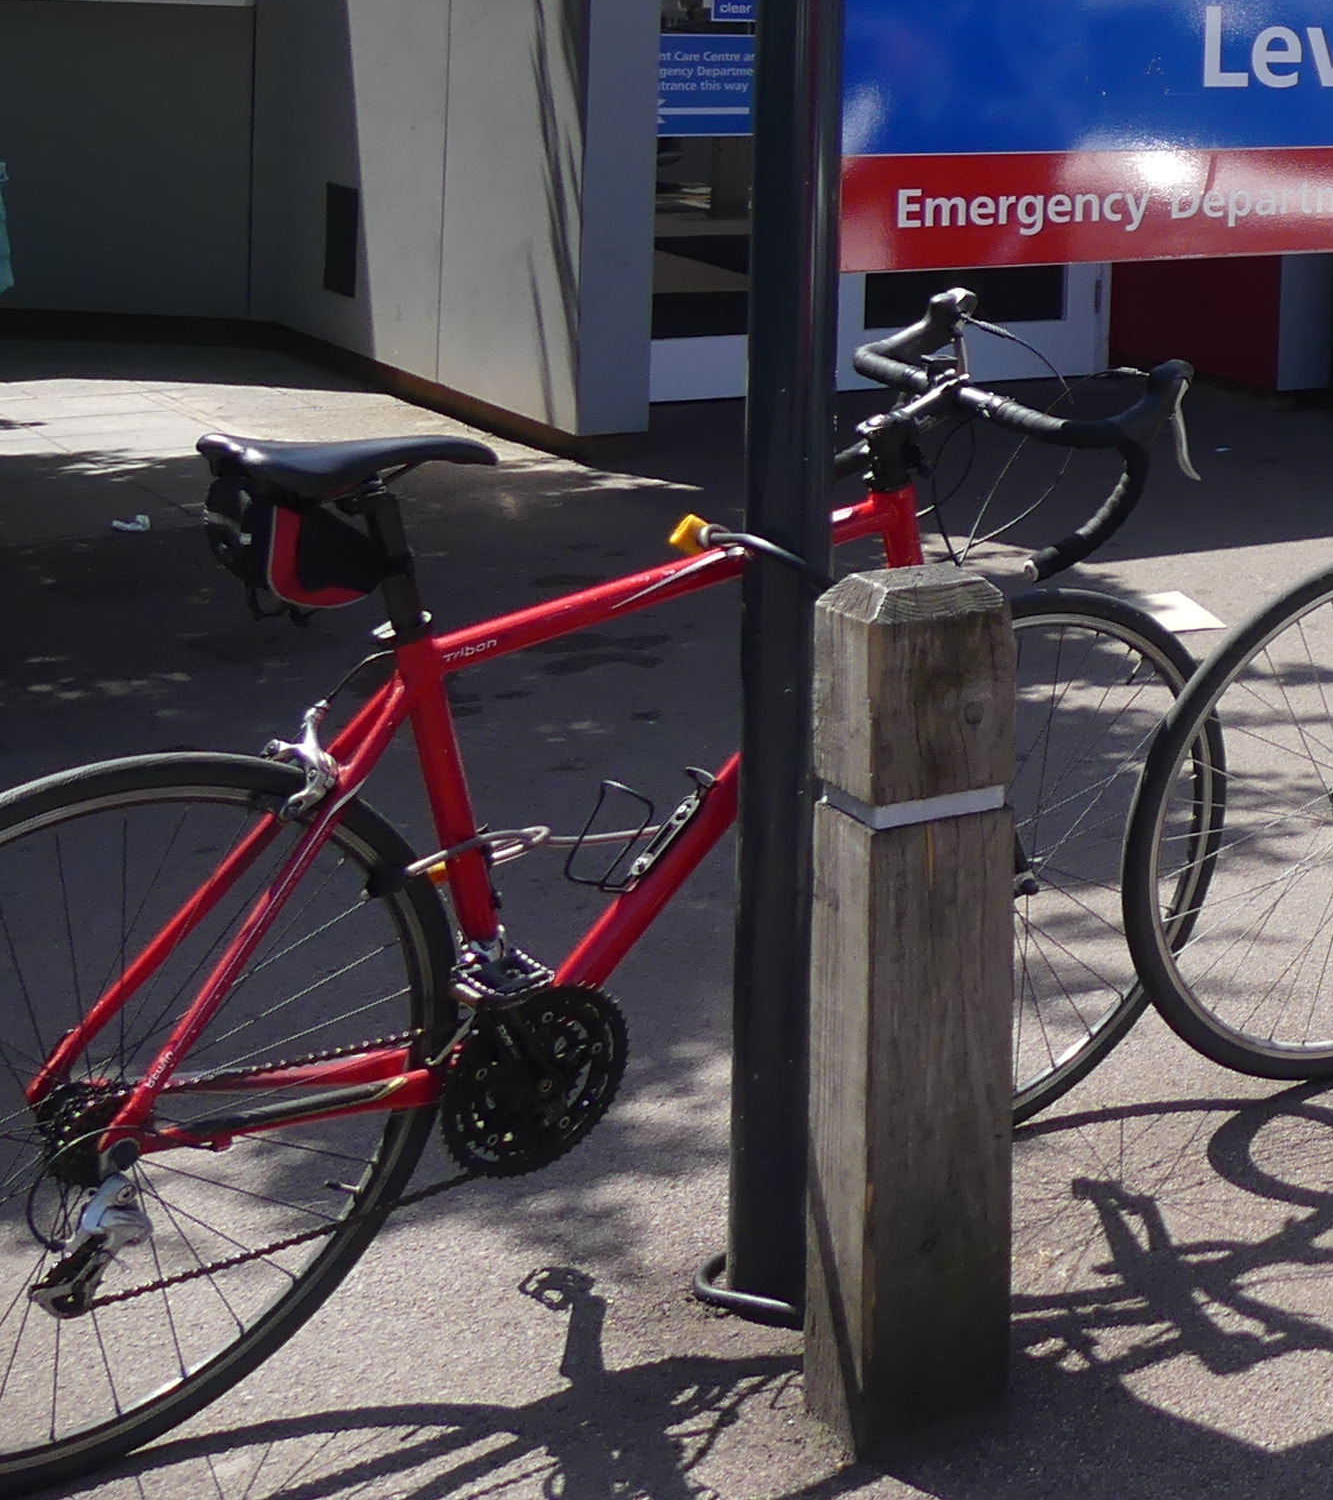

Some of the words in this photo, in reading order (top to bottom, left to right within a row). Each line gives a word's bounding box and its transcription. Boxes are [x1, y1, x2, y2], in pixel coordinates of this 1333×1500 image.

[719, 3, 752, 14] clear
[674, 51, 700, 62] Care
[703, 51, 741, 62] Centre
[700, 80, 722, 91] this
[724, 83, 749, 94] way
[896, 187, 1149, 235] Emergency
